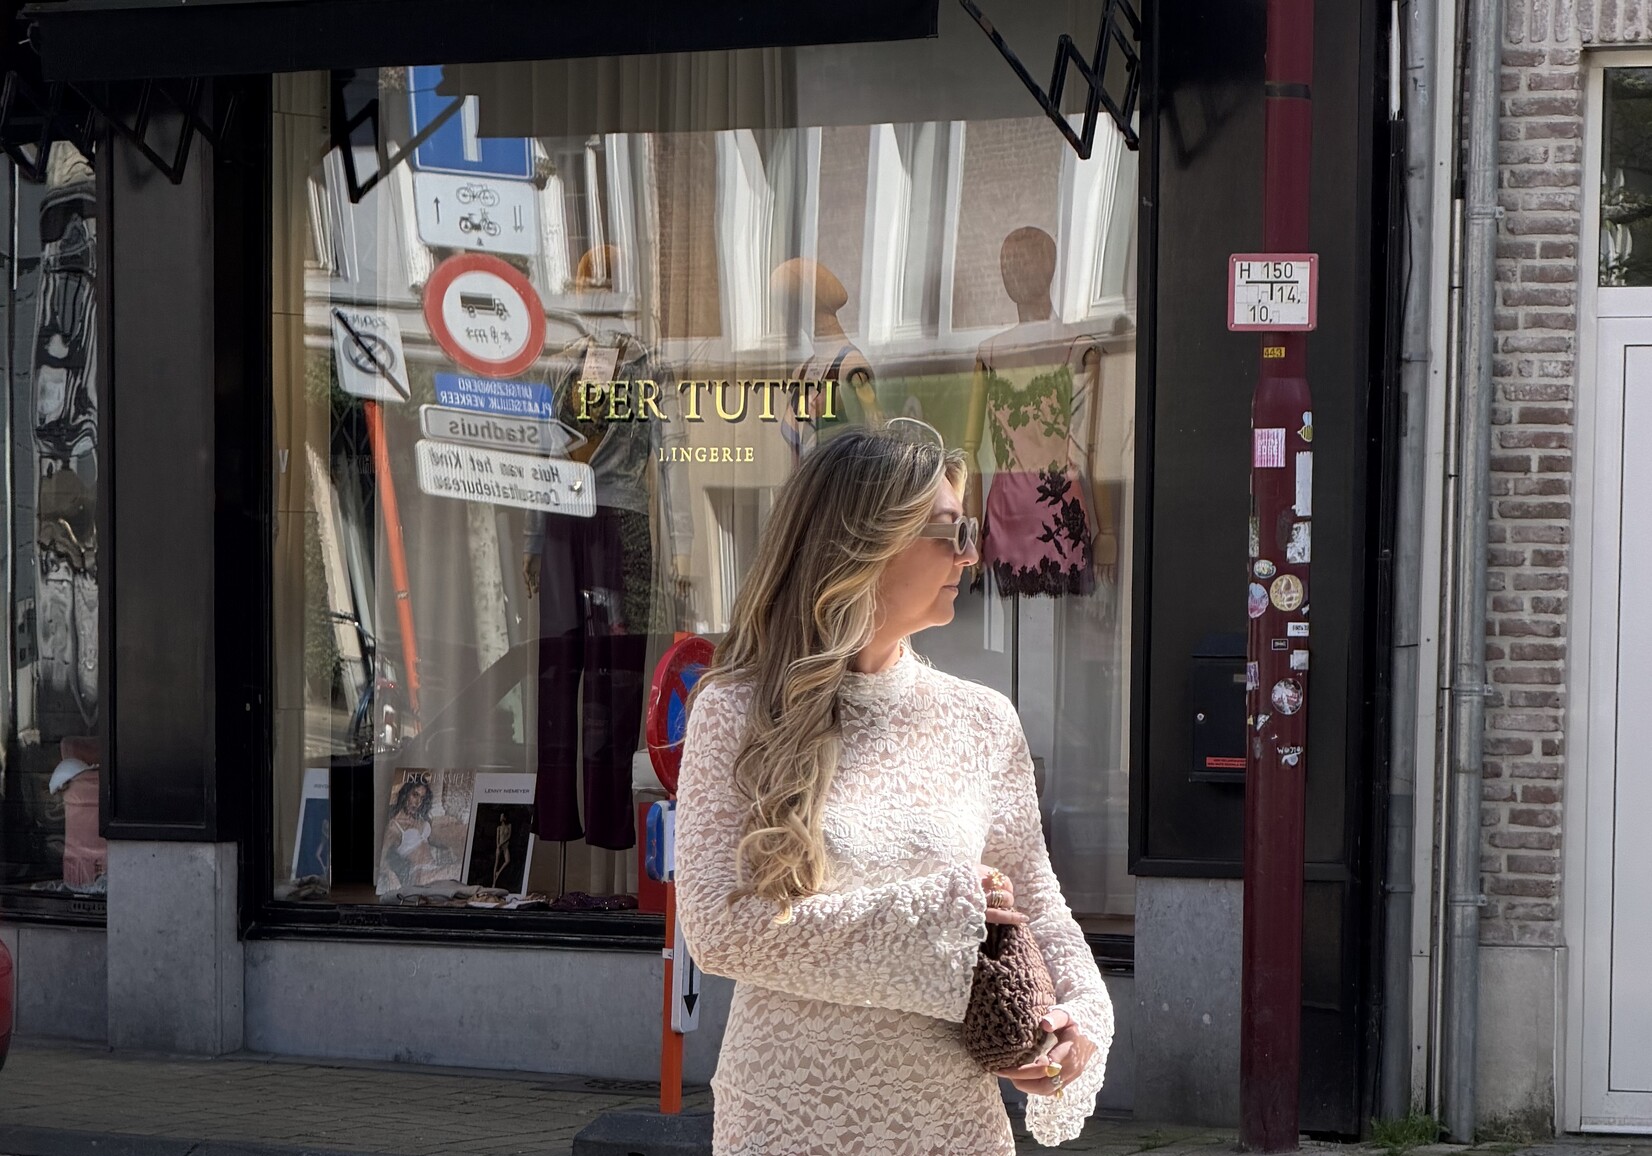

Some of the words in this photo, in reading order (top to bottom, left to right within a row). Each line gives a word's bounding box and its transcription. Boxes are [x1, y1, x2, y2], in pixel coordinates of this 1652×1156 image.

[1239, 262, 1251, 279] H
[1263, 262, 1293, 279] 150
[576, 379, 668, 421] PER
[677, 379, 839, 421] TUTTI
[658, 447, 755, 463] LINGERIE
